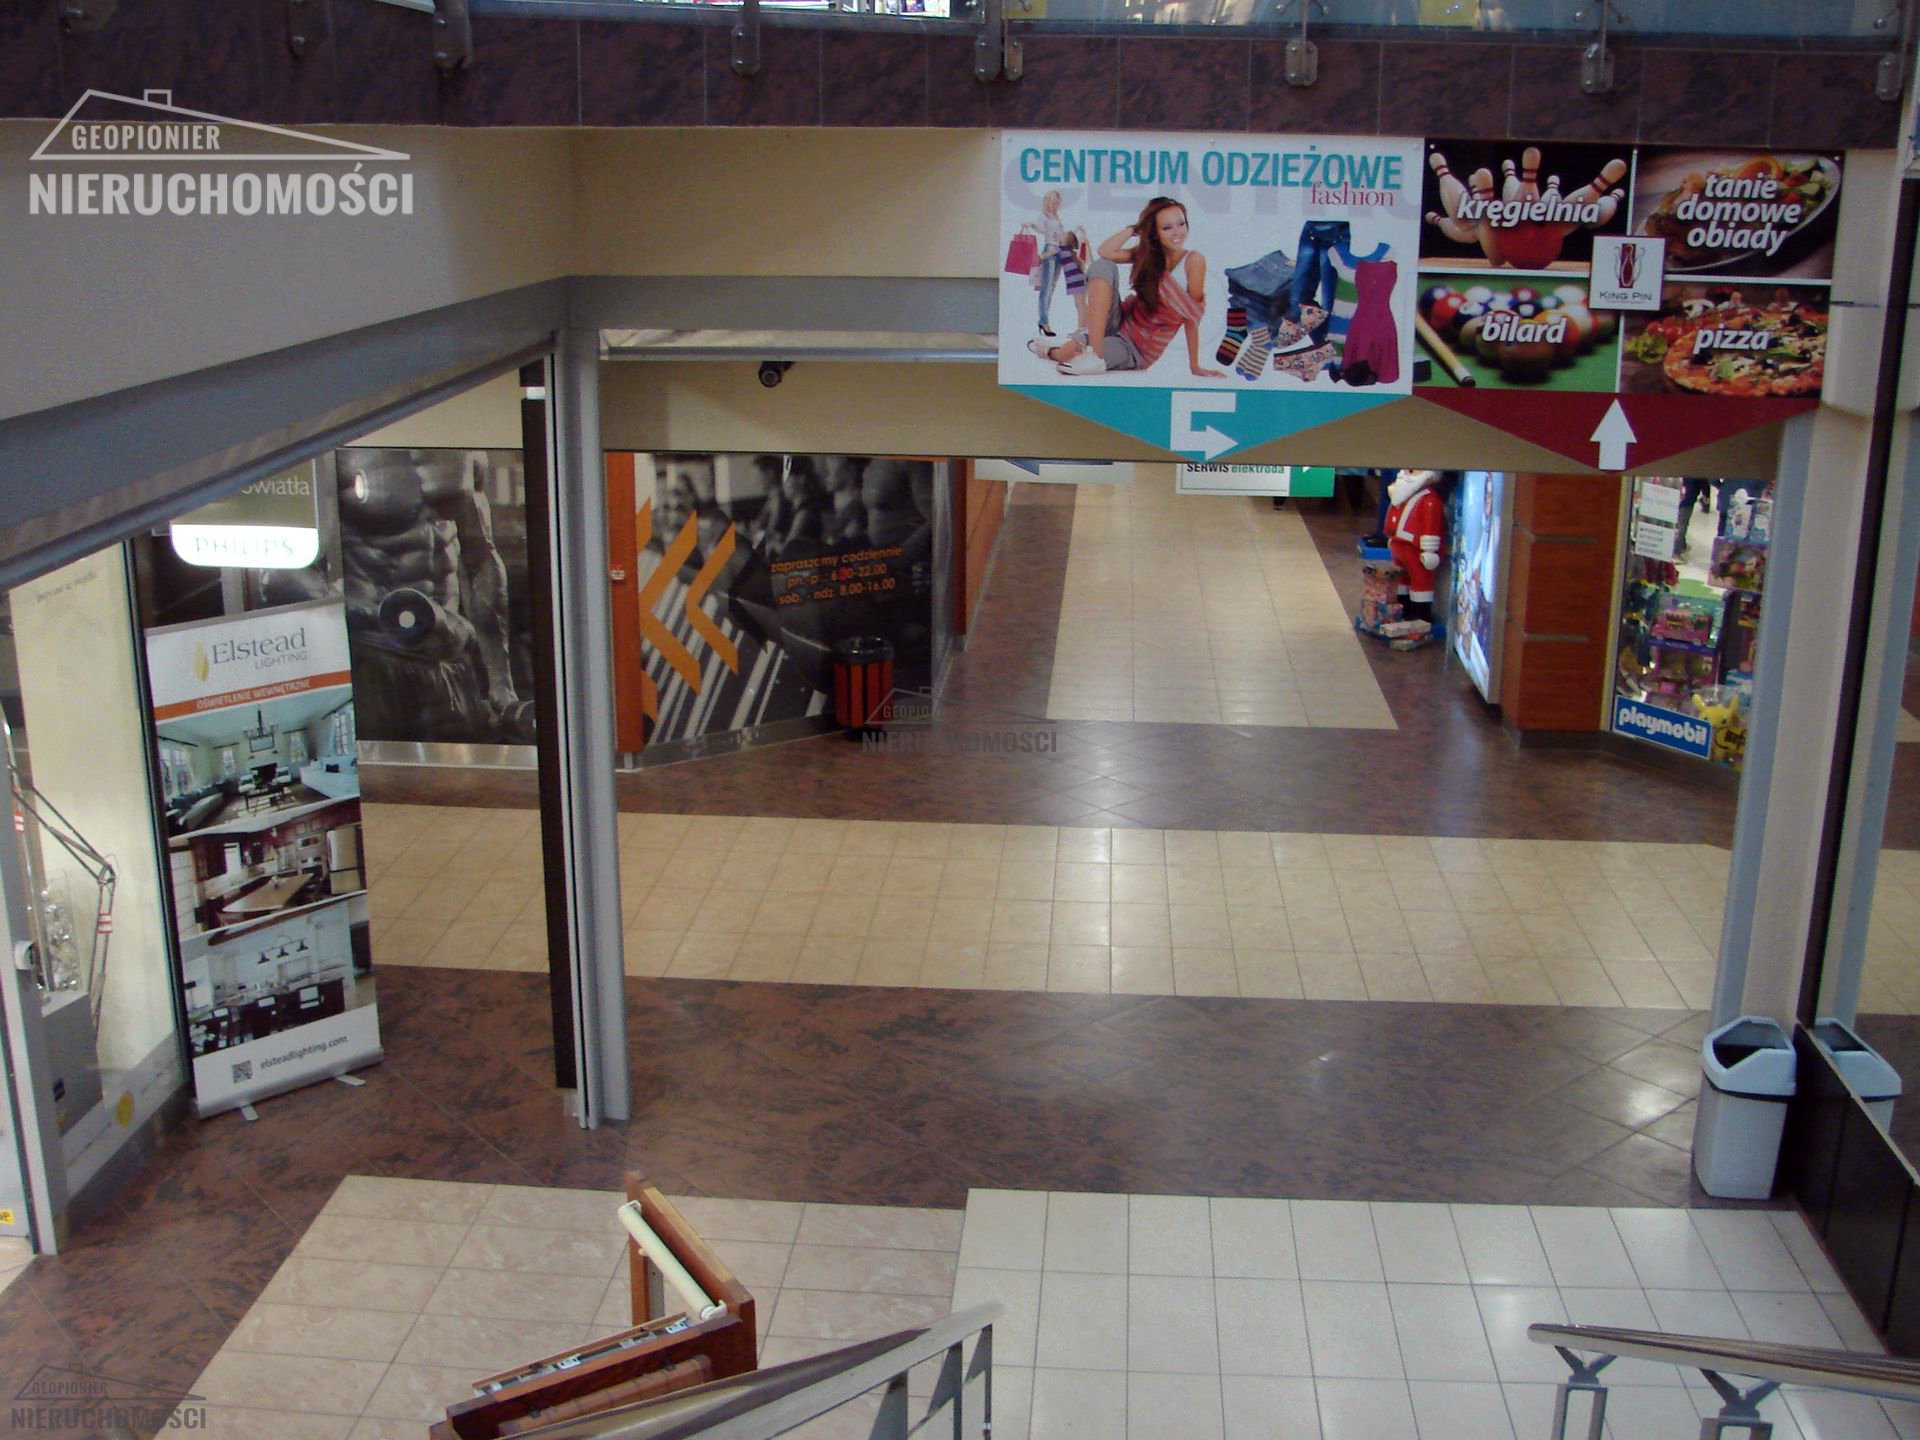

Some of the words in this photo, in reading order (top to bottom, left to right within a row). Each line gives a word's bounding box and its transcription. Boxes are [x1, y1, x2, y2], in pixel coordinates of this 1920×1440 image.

[1019, 147, 1189, 185] CENTRUM
[1202, 145, 1403, 190] ODZIEŻOWE
[1310, 181, 1395, 207] fashion
[1704, 172, 1778, 199] tanie
[1456, 191, 1601, 228] kręgielnia
[1676, 193, 1802, 223] domowe
[1686, 221, 1788, 257] obiady
[1481, 314, 1568, 344] bilard
[1692, 324, 1771, 354] pizza
[1187, 463, 1229, 473] SERWIS
[841, 546, 903, 564] codziennie
[212, 627, 306, 664] Elstead
[255, 650, 308, 670] LIGHTING
[1618, 706, 1706, 745] playmobil
[259, 1035, 348, 1069] elsteadlighting.com
